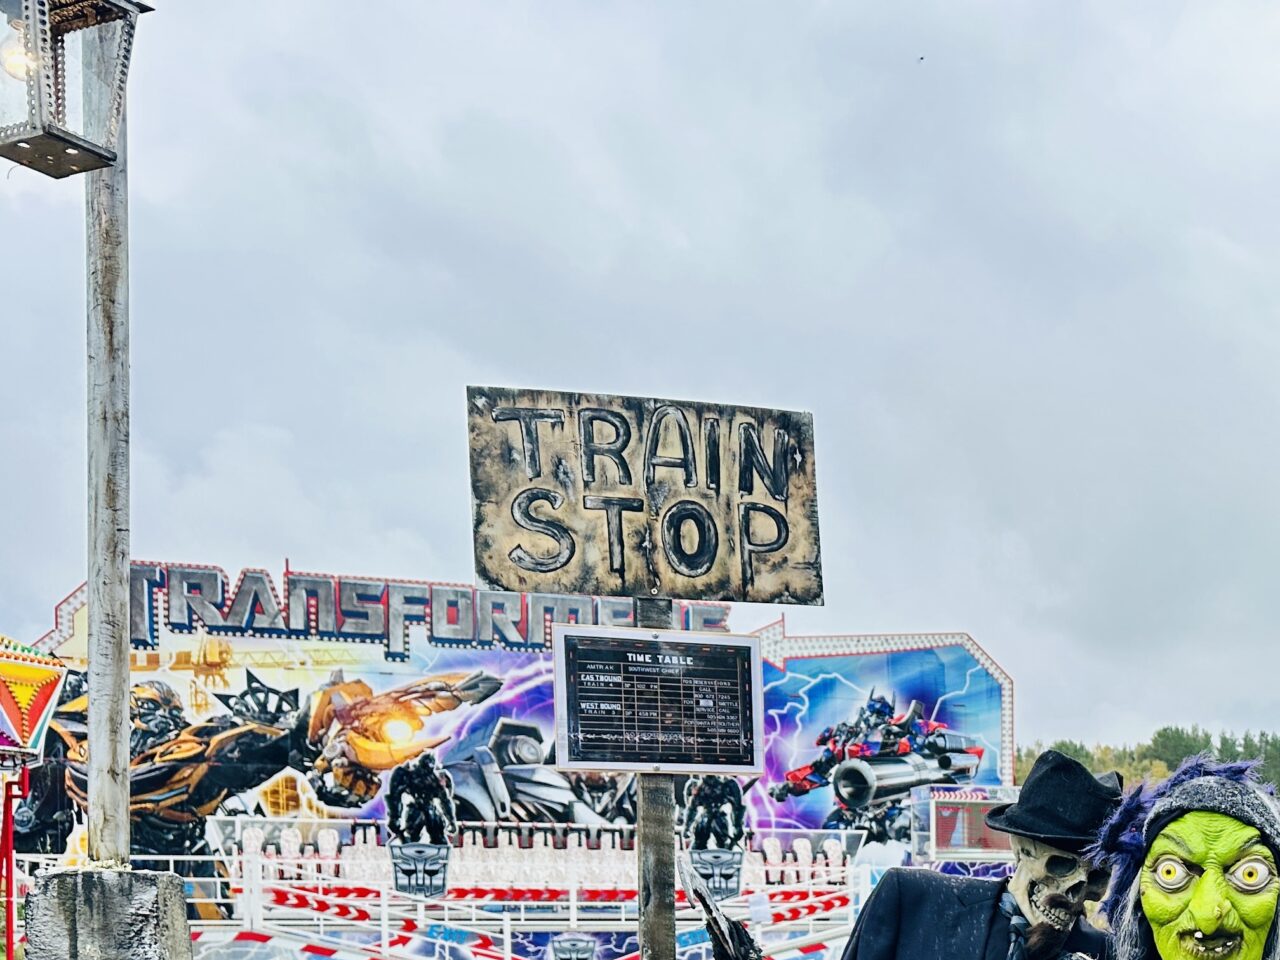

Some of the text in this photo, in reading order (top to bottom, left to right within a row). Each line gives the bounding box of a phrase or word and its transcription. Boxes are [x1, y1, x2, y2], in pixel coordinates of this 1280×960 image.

[491, 404, 789, 500] TRAIN
[508, 487, 790, 593] STOP
[580, 674, 622, 682] EASTBOUND
[627, 653, 694, 665] TIME TABLE
